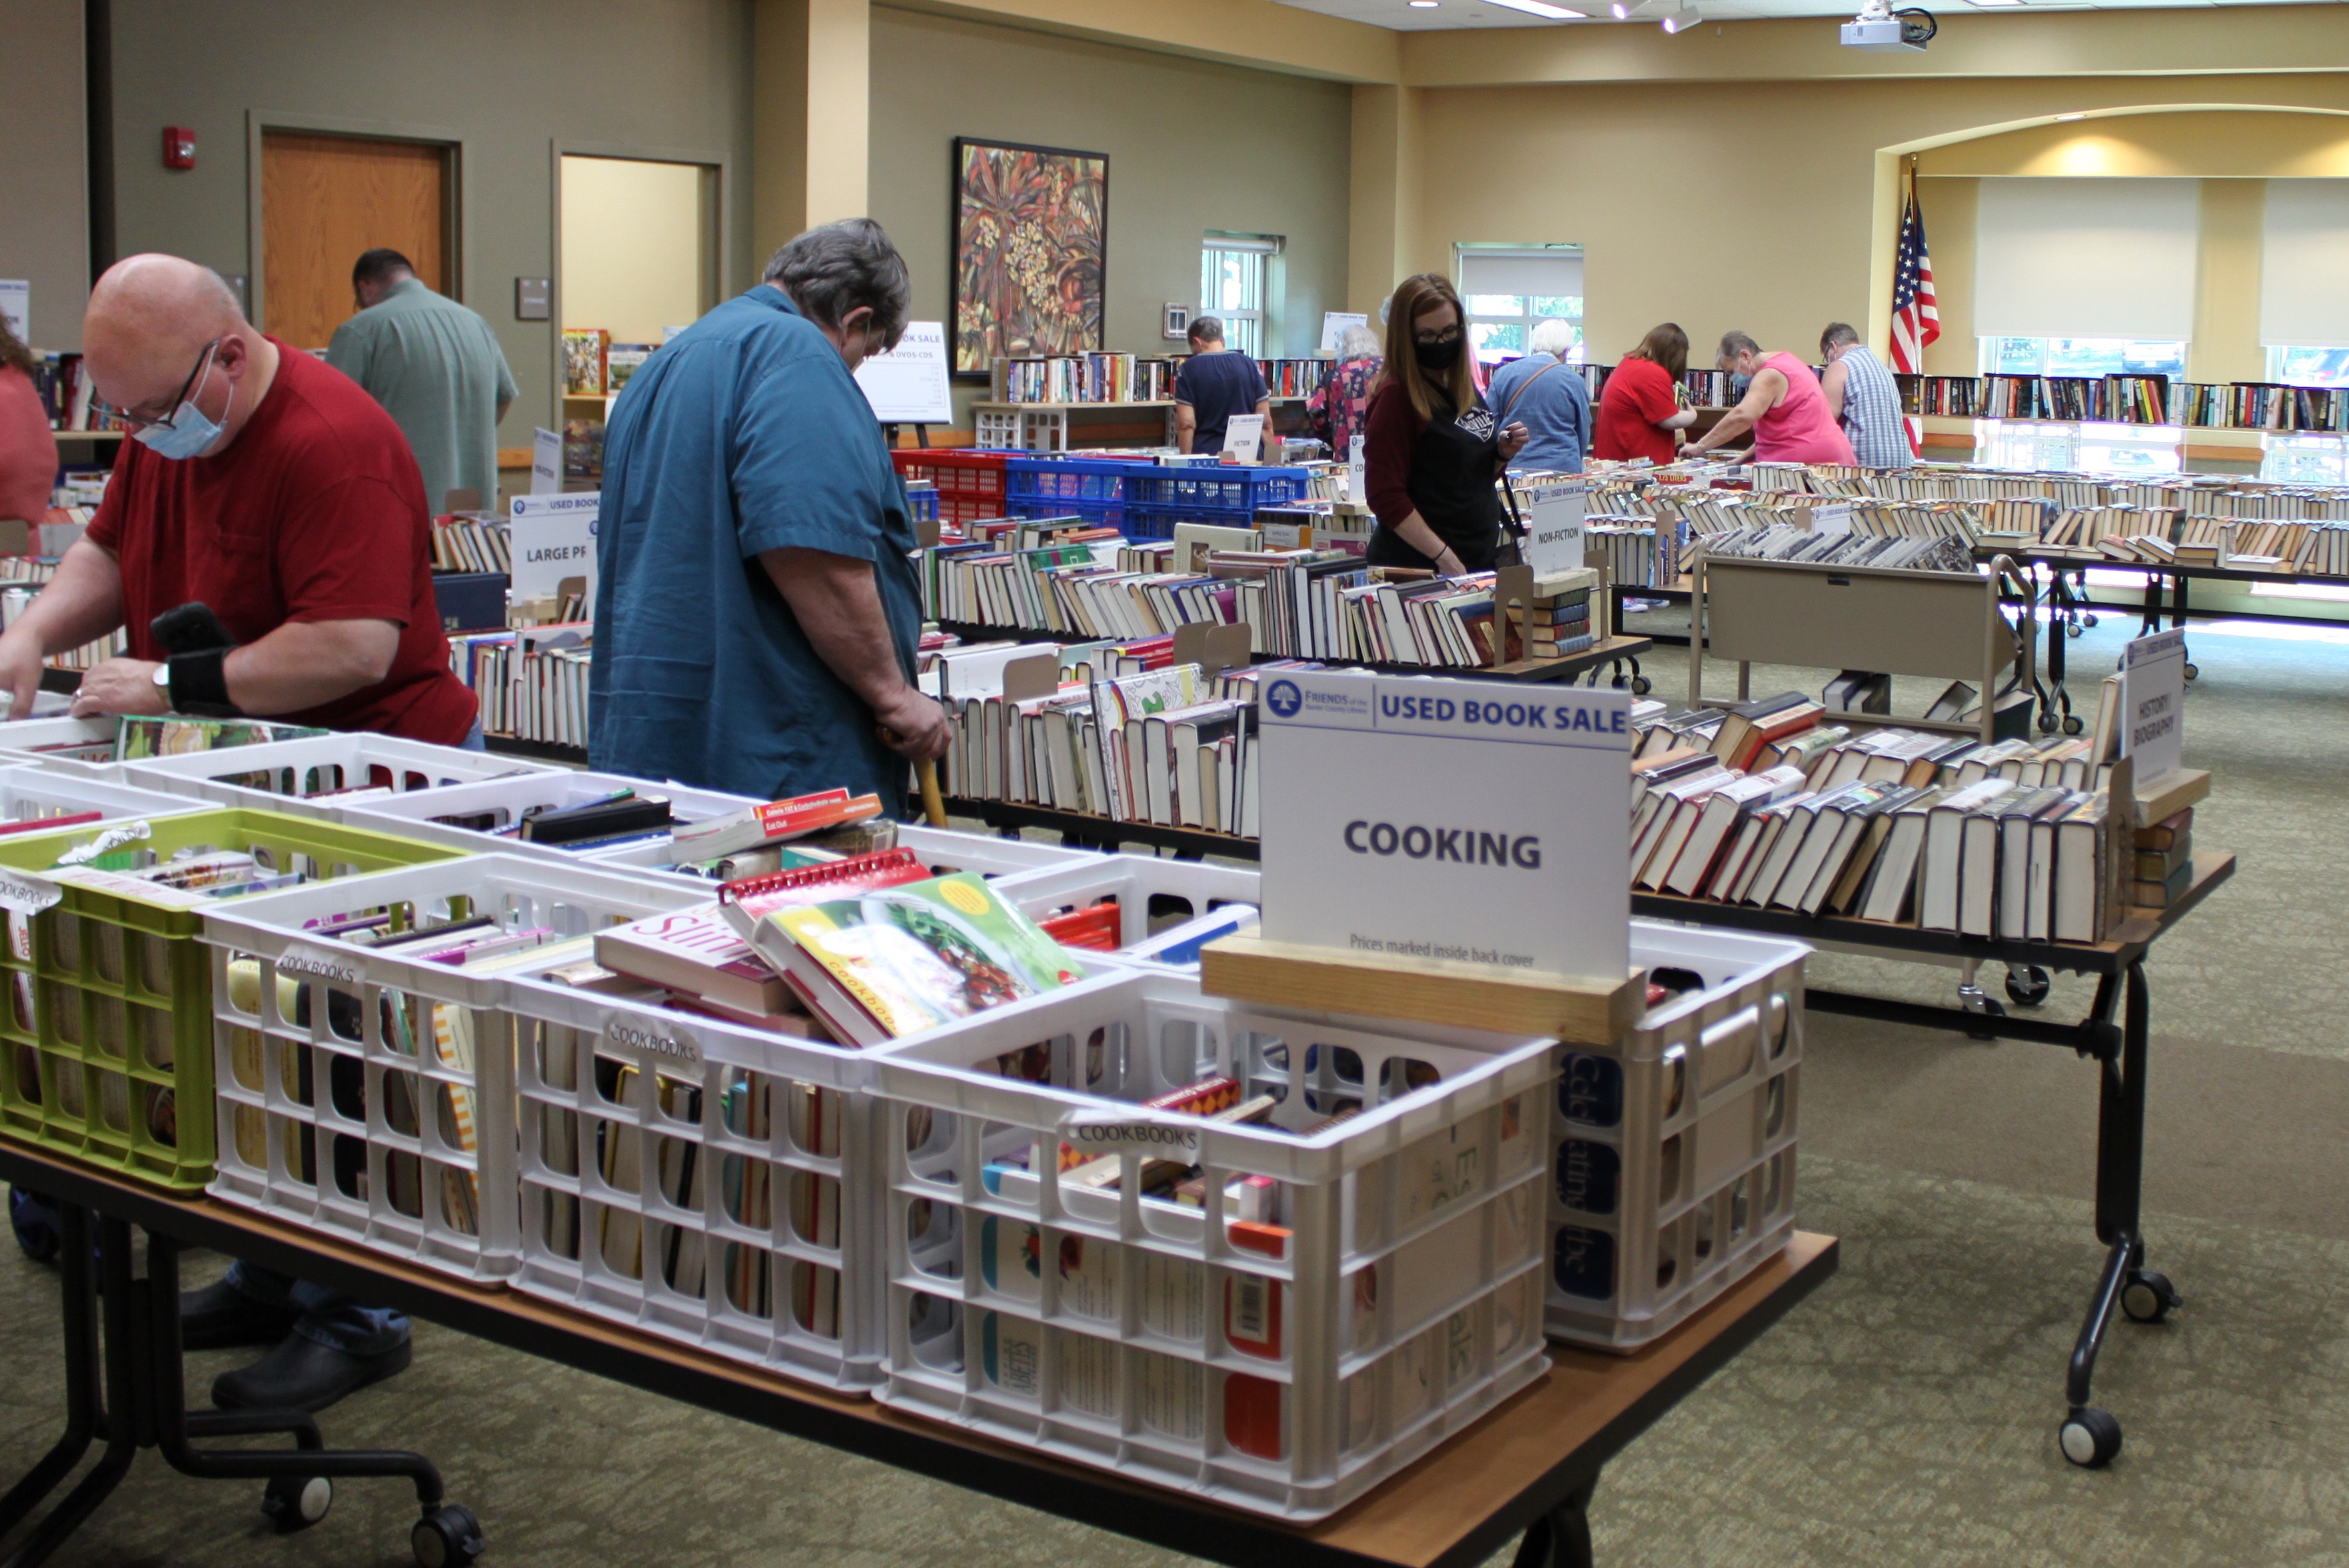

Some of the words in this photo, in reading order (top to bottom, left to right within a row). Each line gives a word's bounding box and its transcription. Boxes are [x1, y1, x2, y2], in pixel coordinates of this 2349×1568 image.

[1563, 487, 1573, 496] BOOK
[1575, 485, 1585, 494] SALE
[550, 500, 573, 510] USED
[575, 498, 598, 508] BOOK
[1539, 527, 1579, 544] NON-FICTION
[526, 547, 569, 562] LARGE
[1305, 691, 1347, 704] FRIENDS
[1381, 695, 1456, 722] USED
[1464, 700, 1547, 728] BOOK
[1554, 706, 1627, 734] SALE
[2134, 715, 2176, 748] BIOGRAPHY
[766, 822, 776, 831] Eat
[776, 820, 788, 829] Out
[1343, 820, 1542, 870] COOKING
[1350, 934, 1383, 951] Prices
[1386, 940, 1431, 957] marked
[1433, 944, 1469, 961] inside
[1471, 947, 1498, 964] back
[1502, 955, 1535, 968] cover
[281, 955, 355, 983] COOKBOOKS
[610, 1024, 697, 1062] COOKBOOKS
[1078, 1124, 1197, 1150] COOKBOOKS
